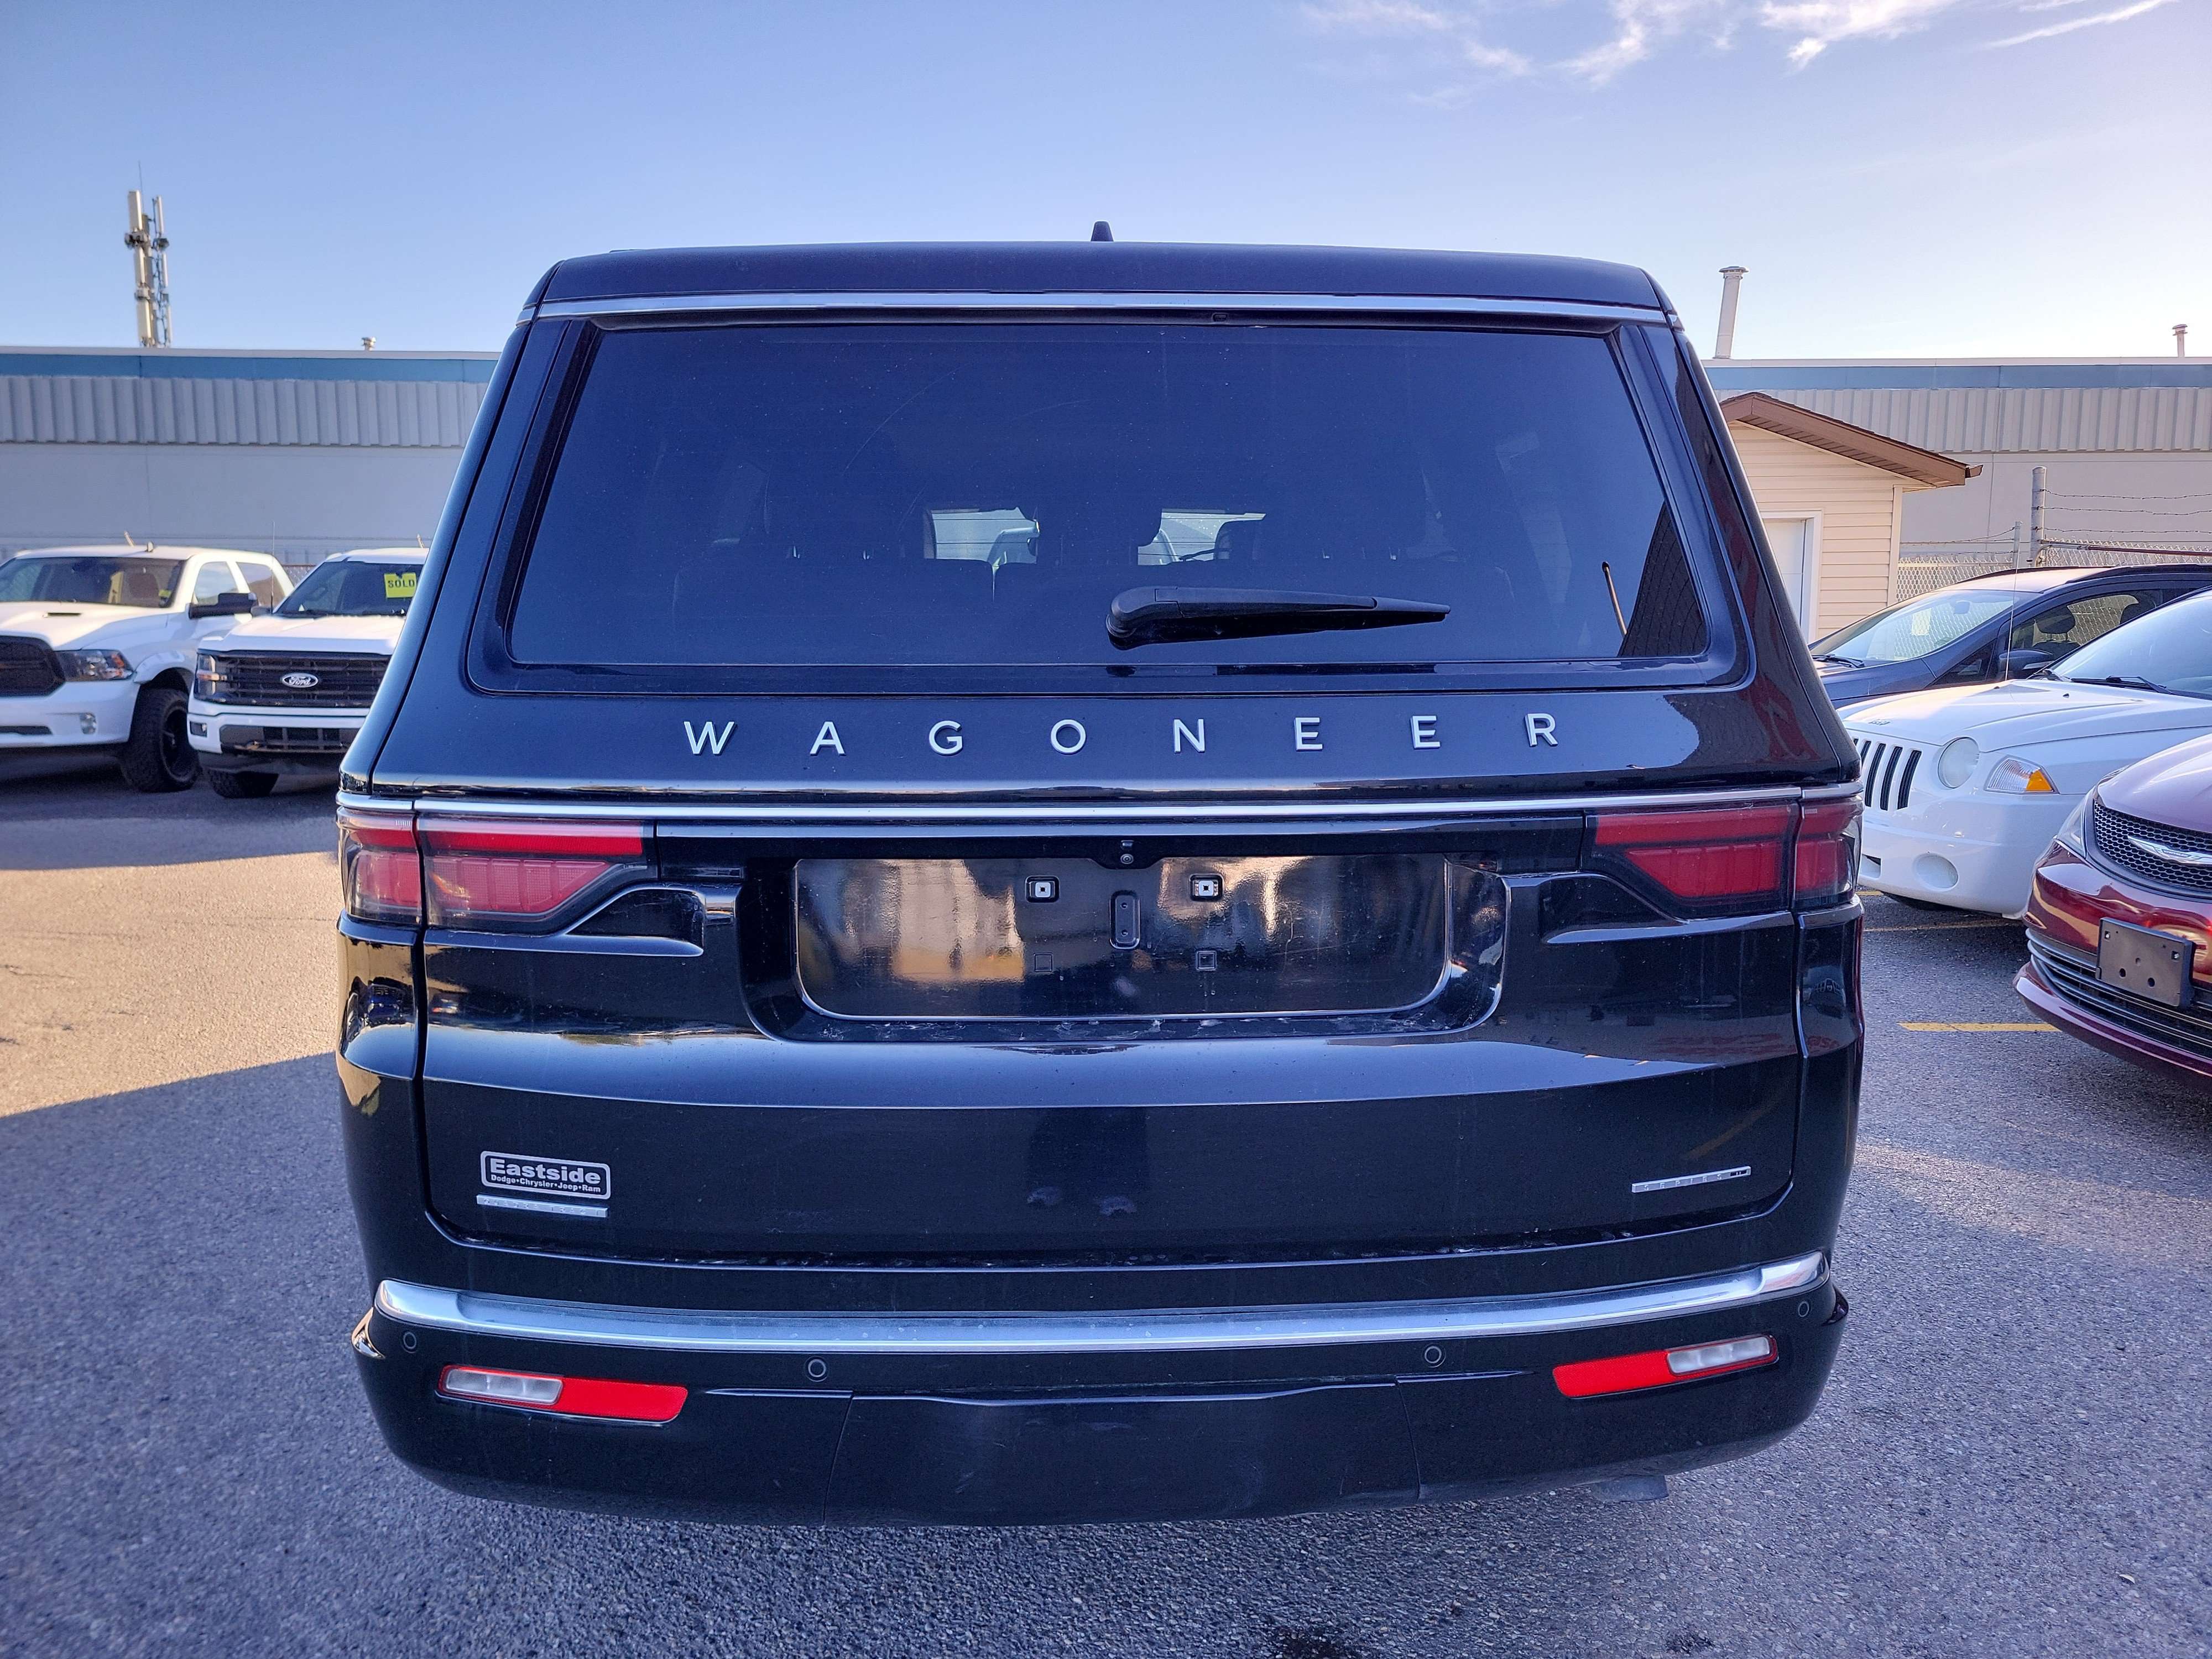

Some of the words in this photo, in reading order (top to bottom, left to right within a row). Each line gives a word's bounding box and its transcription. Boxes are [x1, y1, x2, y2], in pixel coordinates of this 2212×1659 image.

[388, 580, 415, 588] SOLD
[289, 676, 311, 686] Ford
[684, 712, 1558, 755] WAGONEER
[490, 1158, 601, 1184] Eastside
